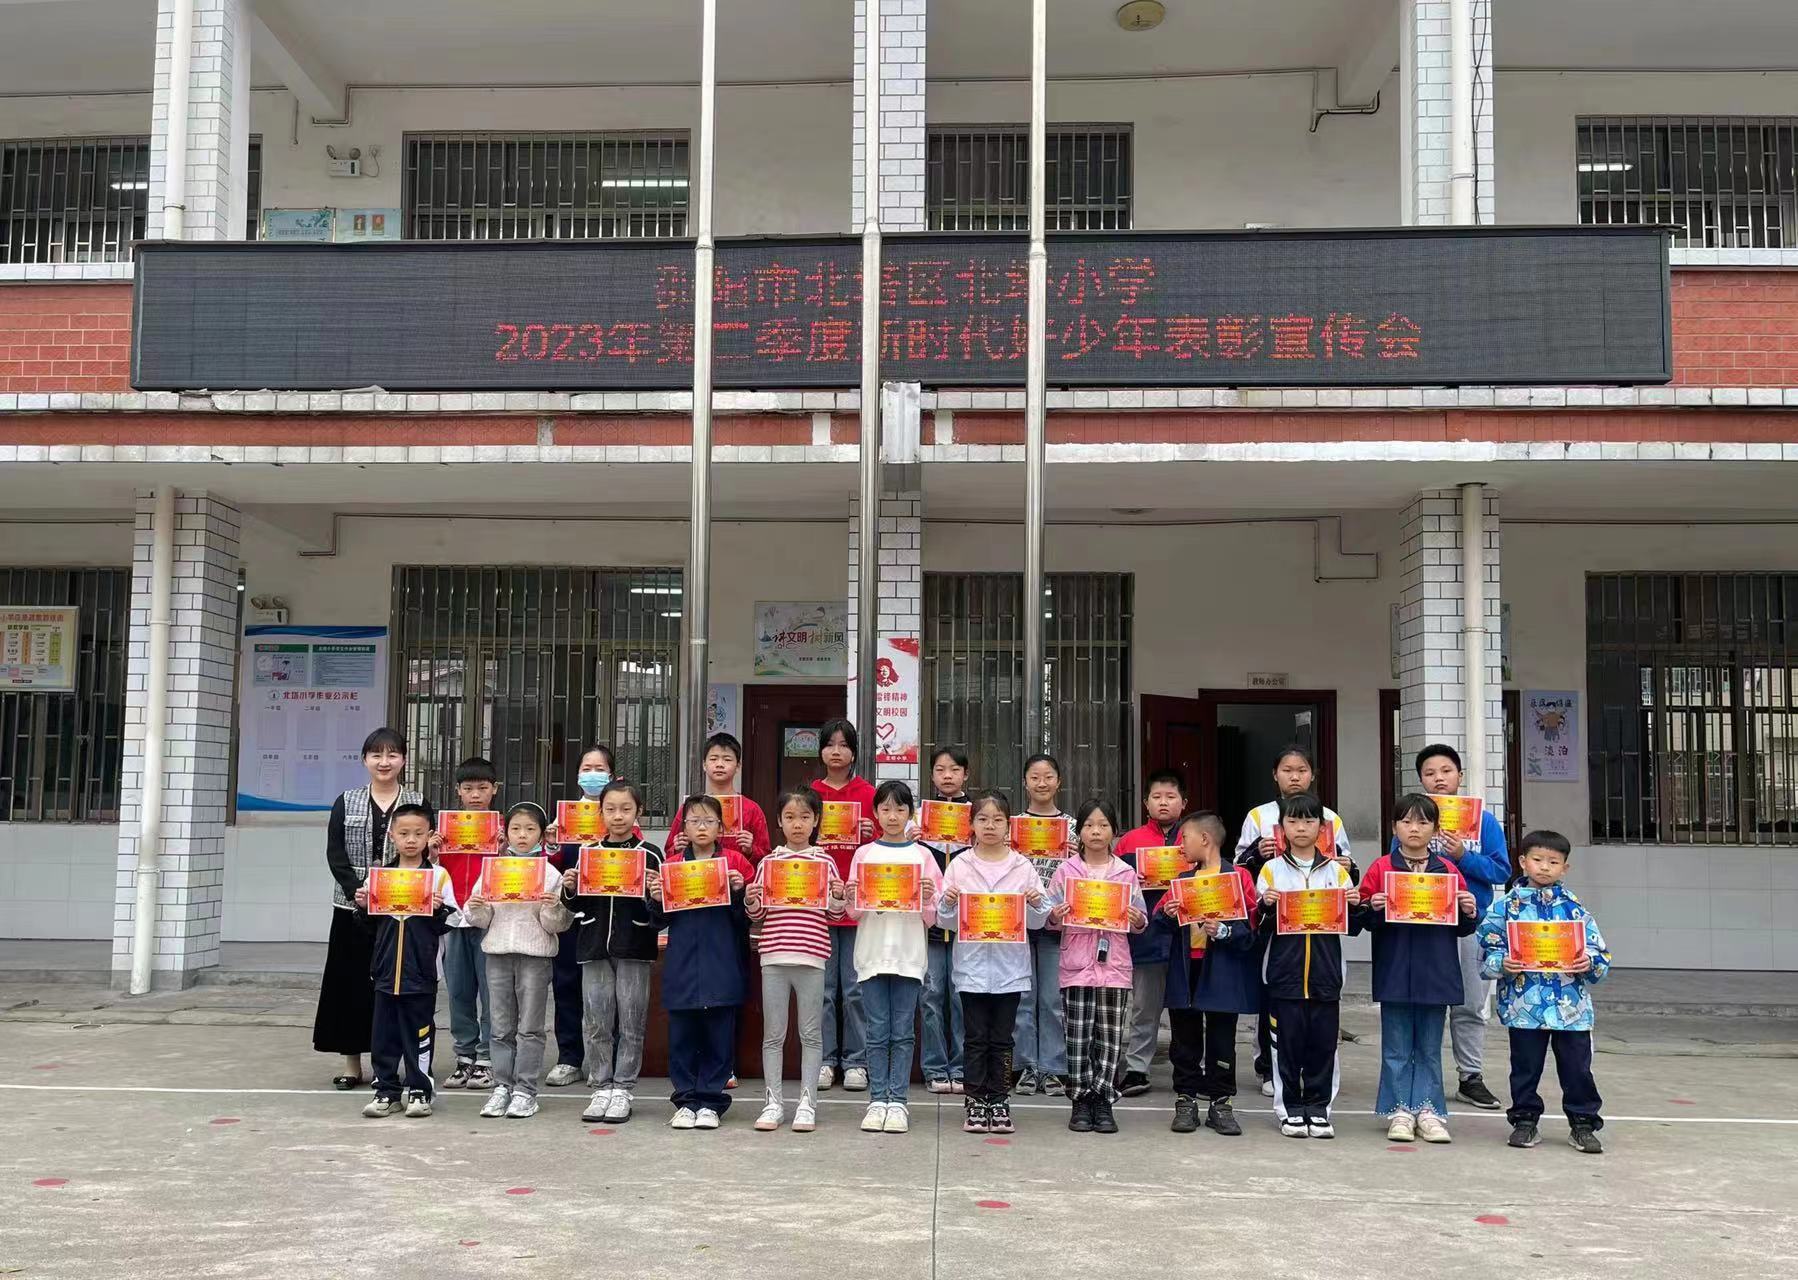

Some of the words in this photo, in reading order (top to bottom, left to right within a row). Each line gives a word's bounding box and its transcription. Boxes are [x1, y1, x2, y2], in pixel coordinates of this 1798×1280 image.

[772, 629, 844, 645] 讲文明树新风
[283, 691, 358, 701] 北塔小学作业公示栏
